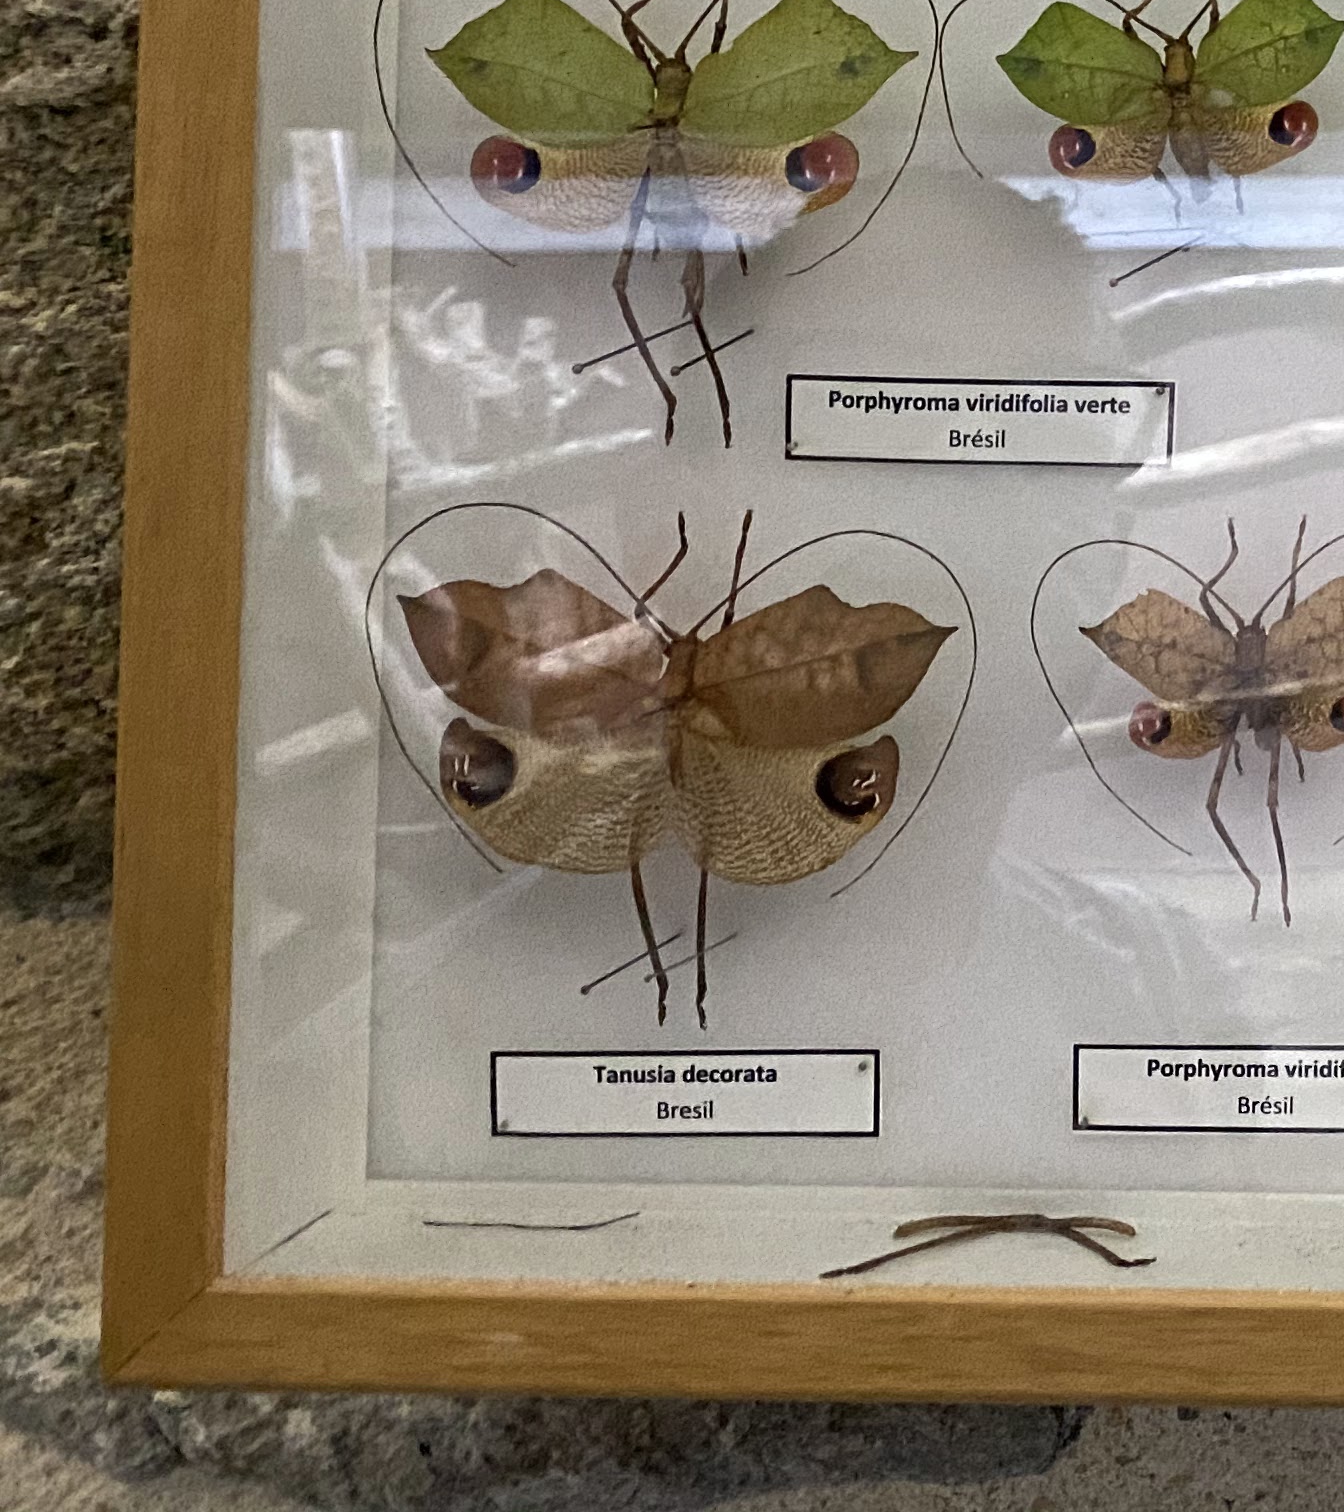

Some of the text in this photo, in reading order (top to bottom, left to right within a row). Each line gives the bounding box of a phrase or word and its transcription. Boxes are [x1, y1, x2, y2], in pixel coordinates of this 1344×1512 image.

[829, 390, 1131, 414] Porphyroma viridifolia verte
[949, 429, 1006, 448] Brésil
[593, 1064, 778, 1083] Tanusia decorata
[1147, 1058, 1279, 1081] Porphyroma
[657, 1100, 714, 1119] Bresil
[1237, 1096, 1294, 1114] Brésil
